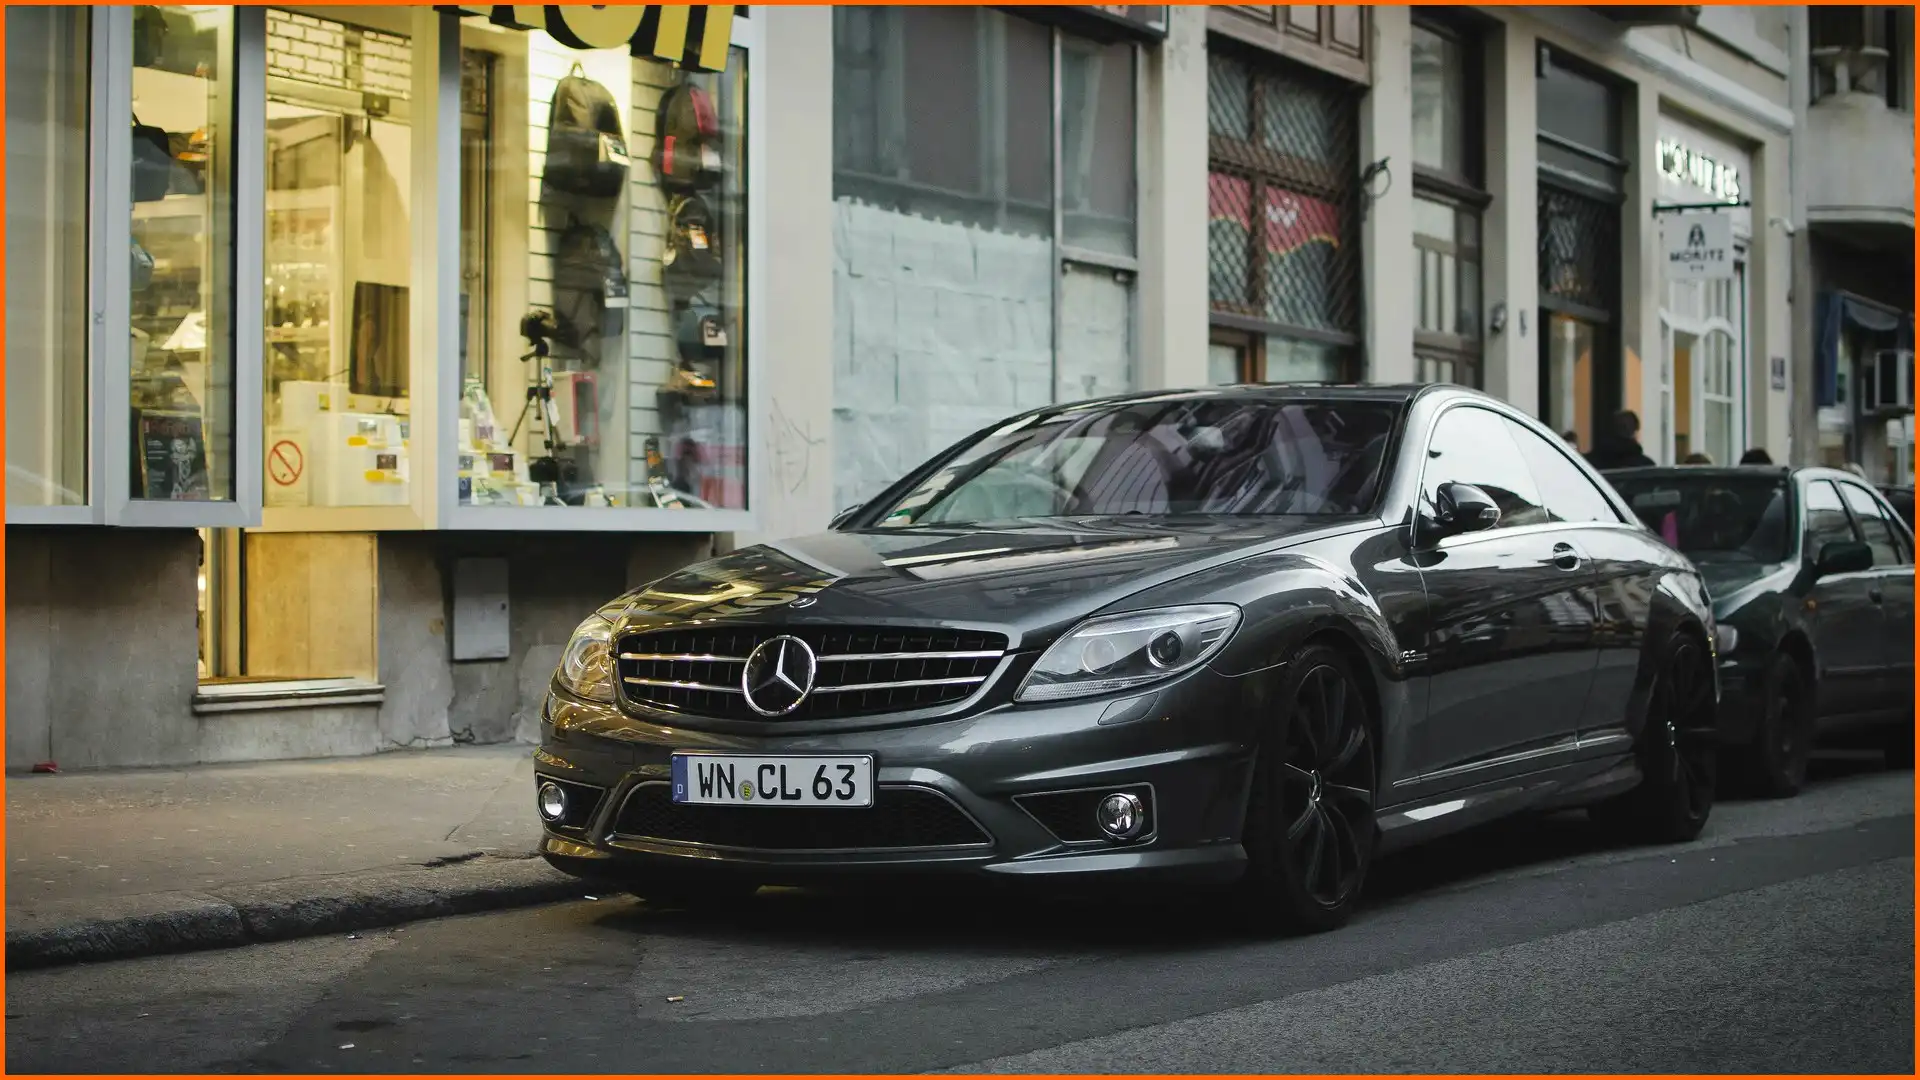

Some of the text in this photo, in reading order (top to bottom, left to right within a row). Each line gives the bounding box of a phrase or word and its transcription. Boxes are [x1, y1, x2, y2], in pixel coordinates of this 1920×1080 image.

[698, 762, 856, 800] WN CL 63
